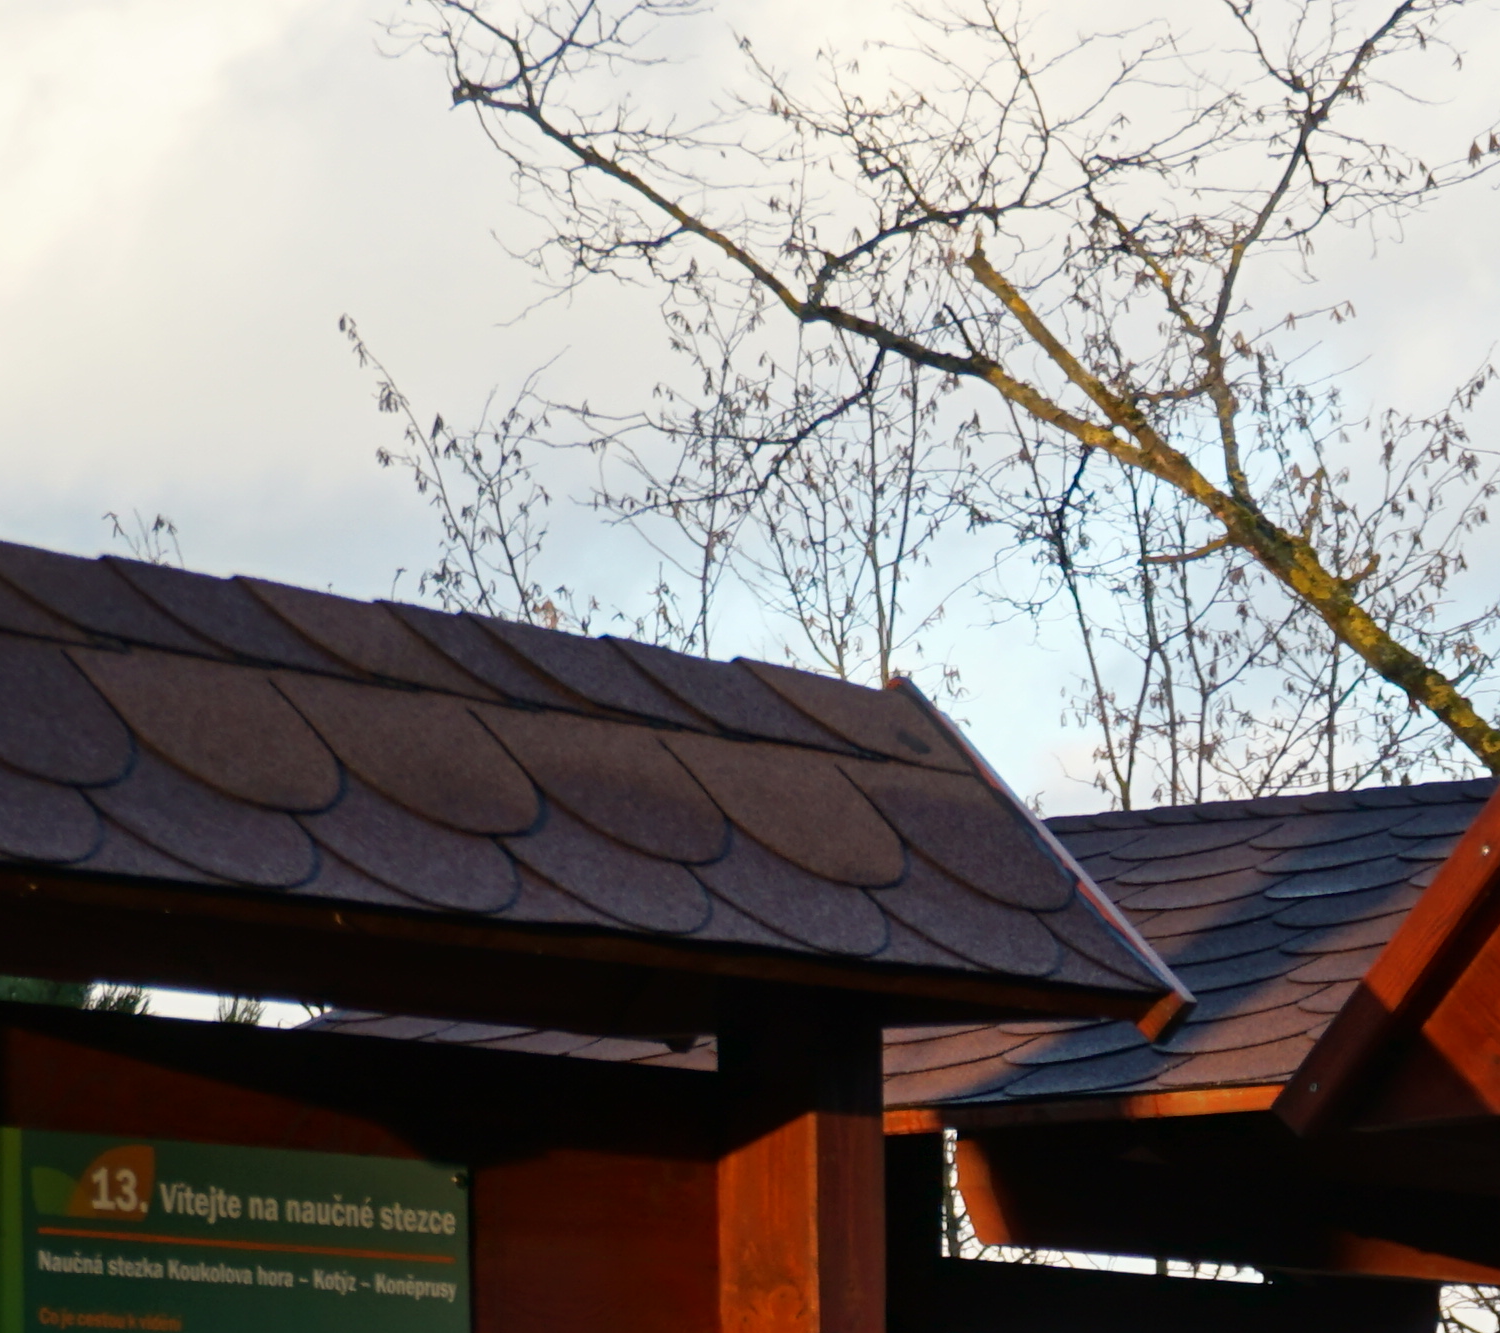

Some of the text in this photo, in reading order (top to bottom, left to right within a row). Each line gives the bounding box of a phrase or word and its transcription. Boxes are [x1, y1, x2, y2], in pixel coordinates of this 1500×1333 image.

[91, 1167, 456, 1235] 13. Vítejte na naučné stezce
[38, 1249, 103, 1275] Naučná
[107, 1256, 163, 1279] stezka
[168, 1259, 253, 1285] Koukolova
[258, 1265, 294, 1288] hora
[313, 1269, 357, 1295] Kotýz
[375, 1273, 457, 1302] Koněprusy
